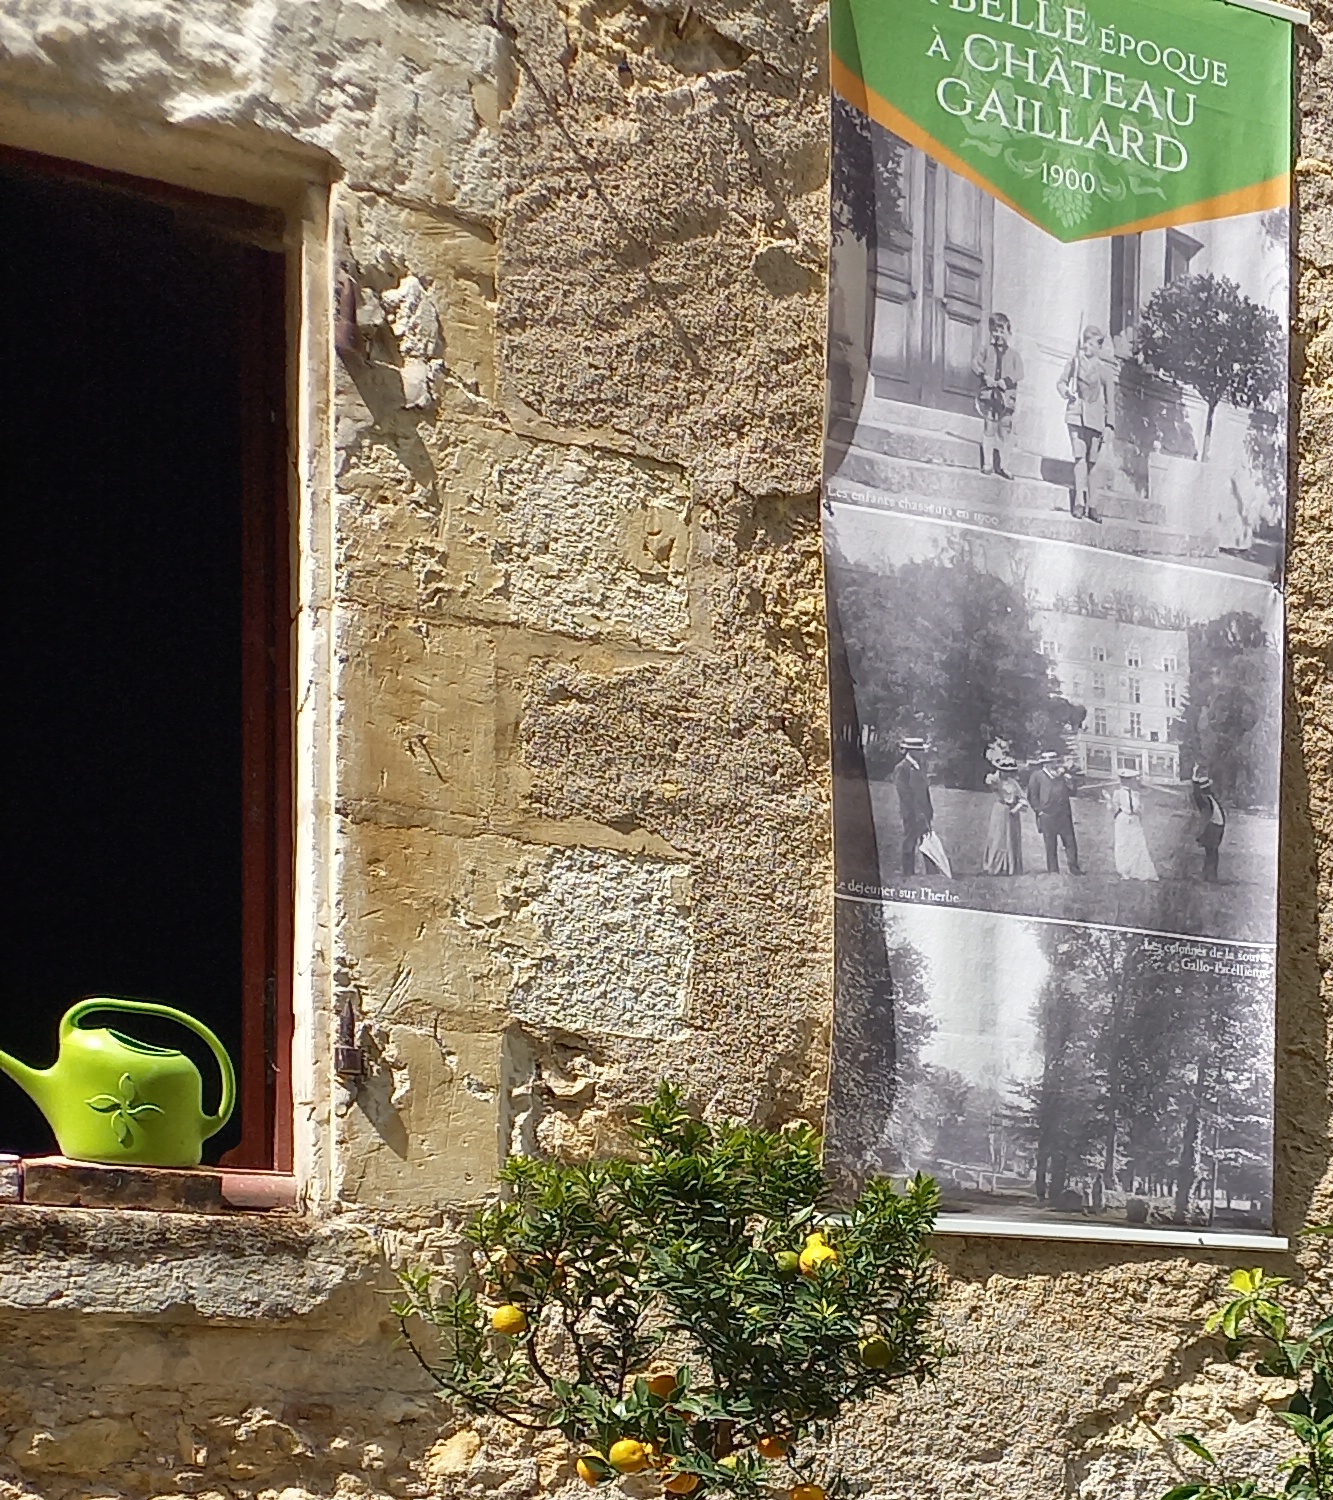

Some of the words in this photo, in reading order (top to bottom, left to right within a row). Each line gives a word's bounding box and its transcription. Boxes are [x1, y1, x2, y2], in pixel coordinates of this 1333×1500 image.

[949, 0, 1088, 45] ELLE
[1100, 24, 1228, 88] ÉPOQUE
[925, 24, 950, 62] À
[963, 33, 1197, 127] CHÂTEAU
[936, 76, 1189, 173] GAILLARD
[1040, 161, 1096, 194] 1900
[826, 481, 848, 500] Les
[852, 489, 895, 508] enfants
[898, 496, 953, 516] chasseurs
[956, 508, 970, 520] en
[898, 889, 918, 900] sur
[920, 887, 960, 903] l'herbe
[1210, 945, 1223, 959] de
[1225, 947, 1235, 960] la
